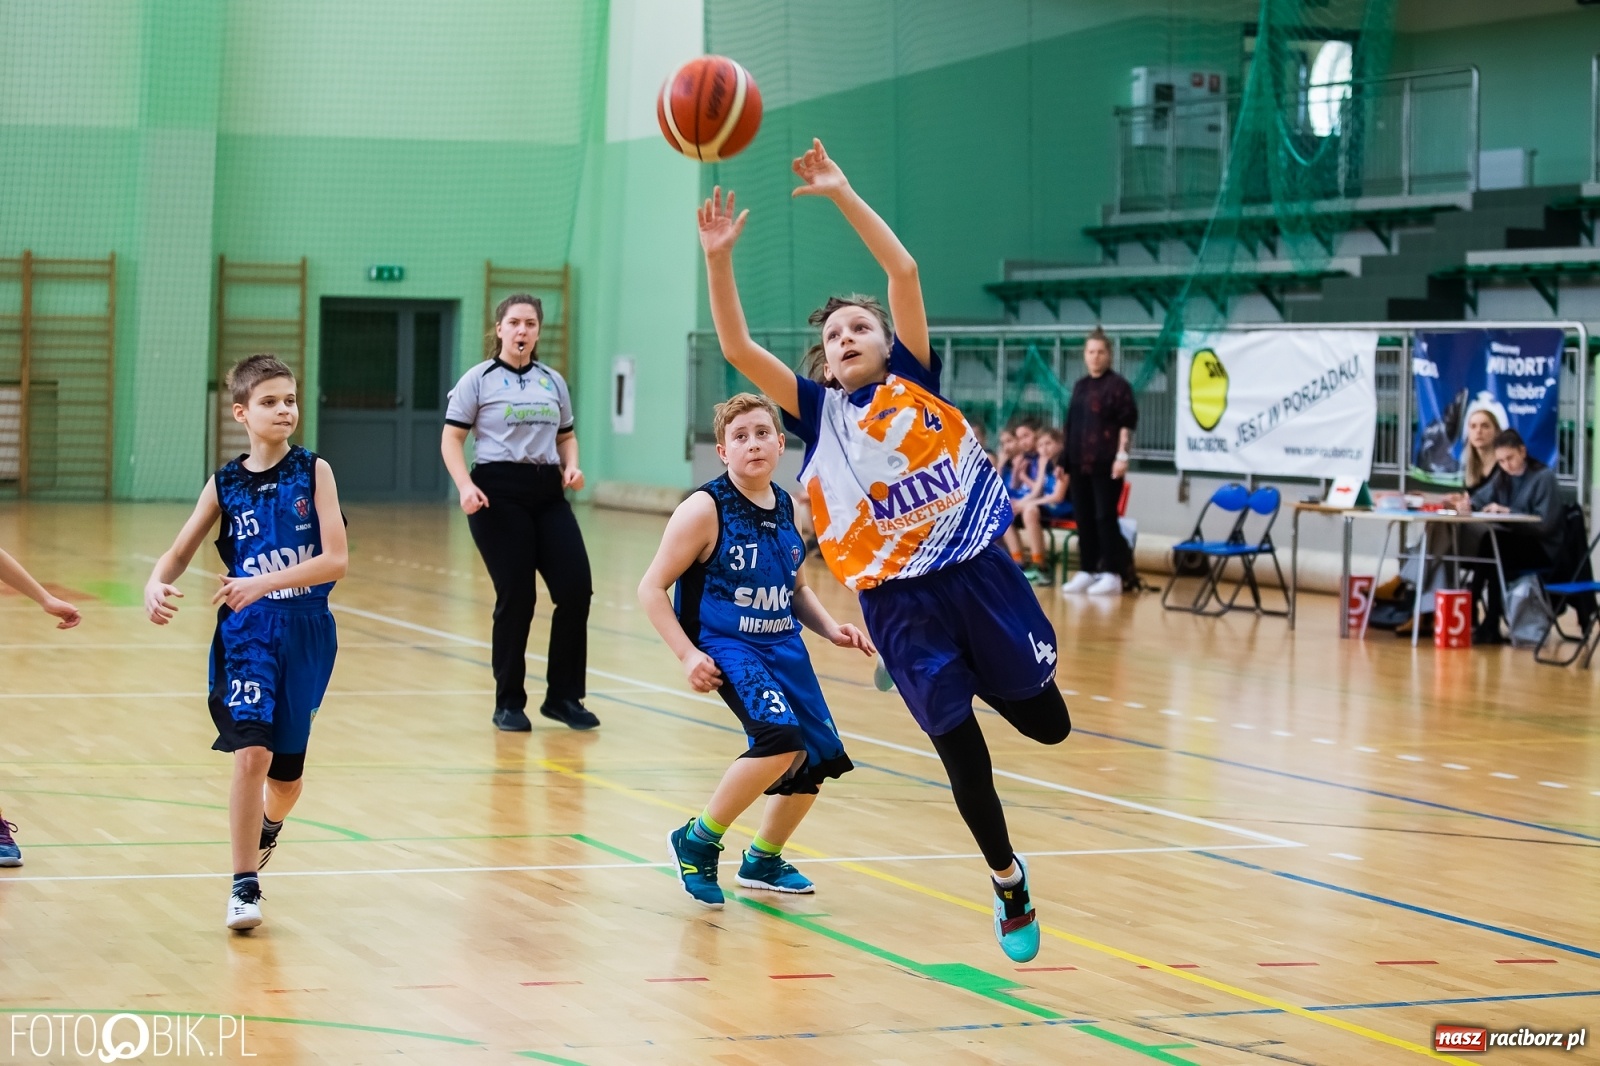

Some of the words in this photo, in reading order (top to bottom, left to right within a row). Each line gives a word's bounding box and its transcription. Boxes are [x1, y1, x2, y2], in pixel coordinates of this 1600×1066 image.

[923, 407, 943, 432] 4
[1235, 411, 1264, 448] JEST
[872, 457, 961, 520] MINI
[729, 543, 758, 571] 37
[1349, 579, 1371, 616] 5
[1448, 596, 1467, 636] 5
[1028, 631, 1057, 666] 4
[228, 679, 261, 707] 25
